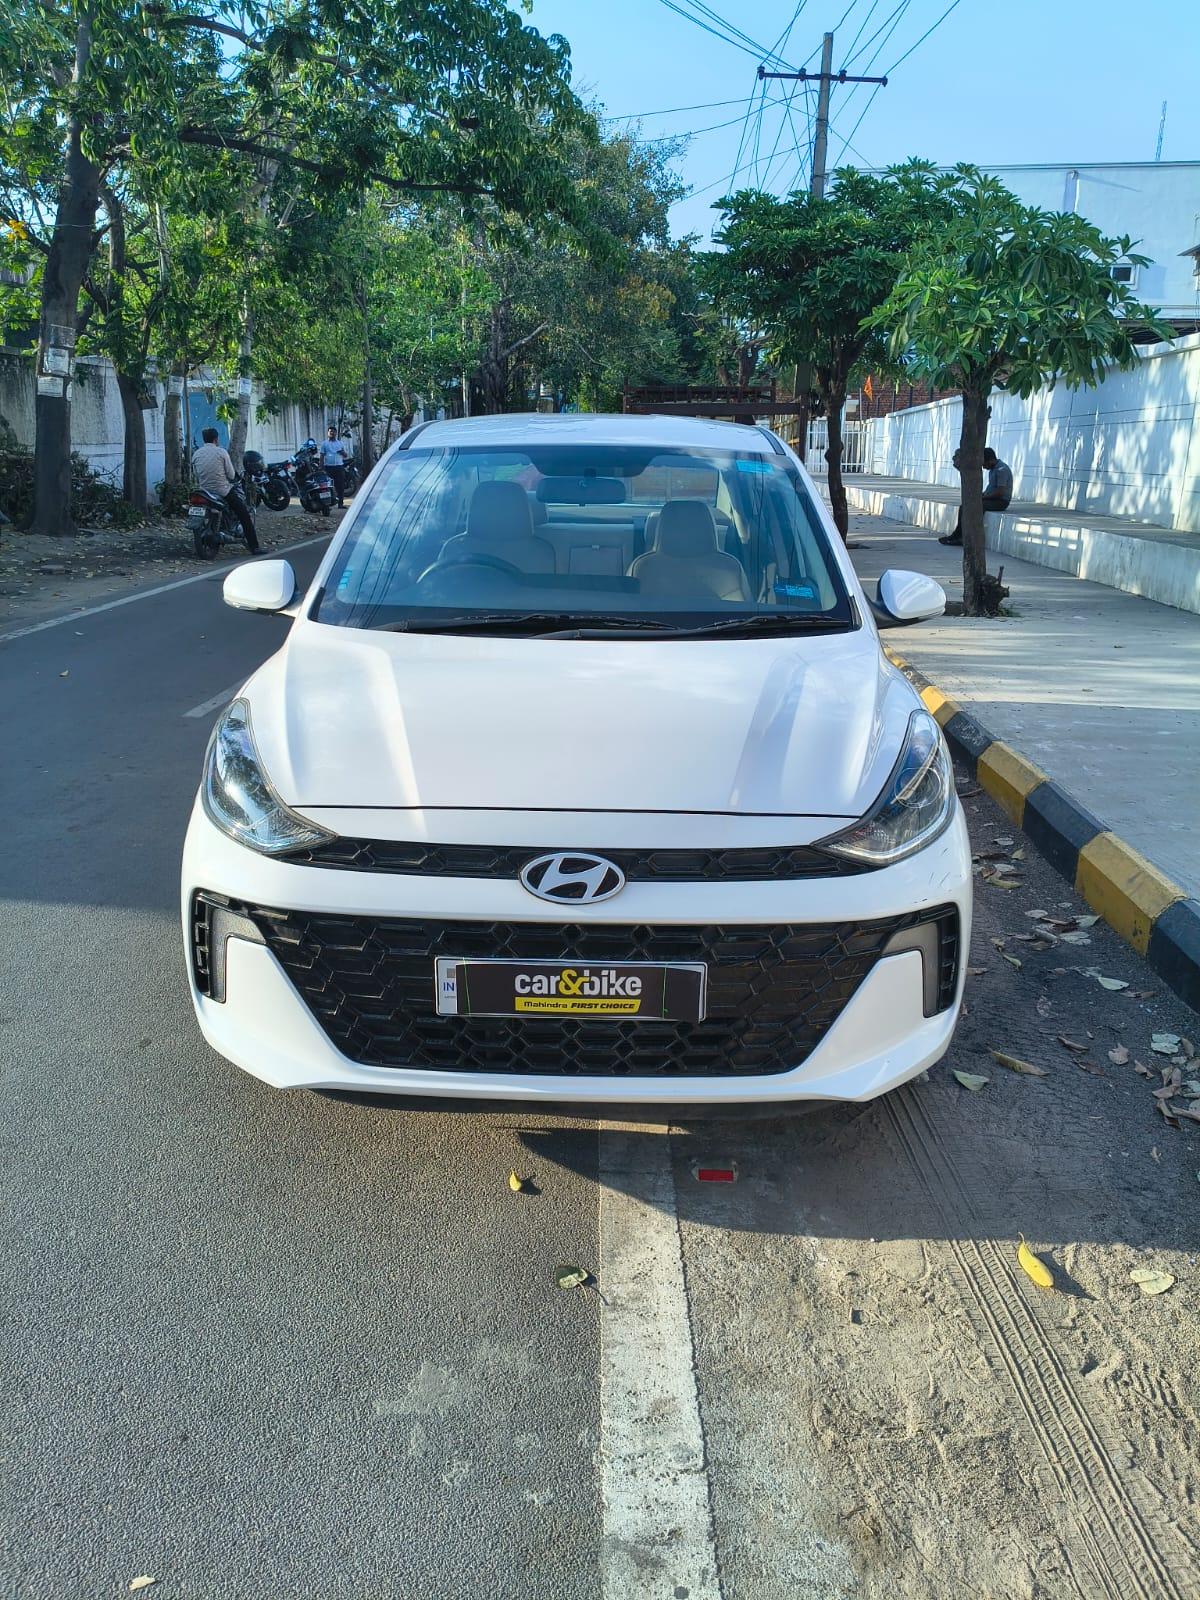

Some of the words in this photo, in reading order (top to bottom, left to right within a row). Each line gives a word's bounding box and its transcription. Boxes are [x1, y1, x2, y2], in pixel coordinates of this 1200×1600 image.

[443, 982, 455, 991] IN
[515, 969, 641, 996] car&bike
[524, 1001, 568, 1009] Mahindra
